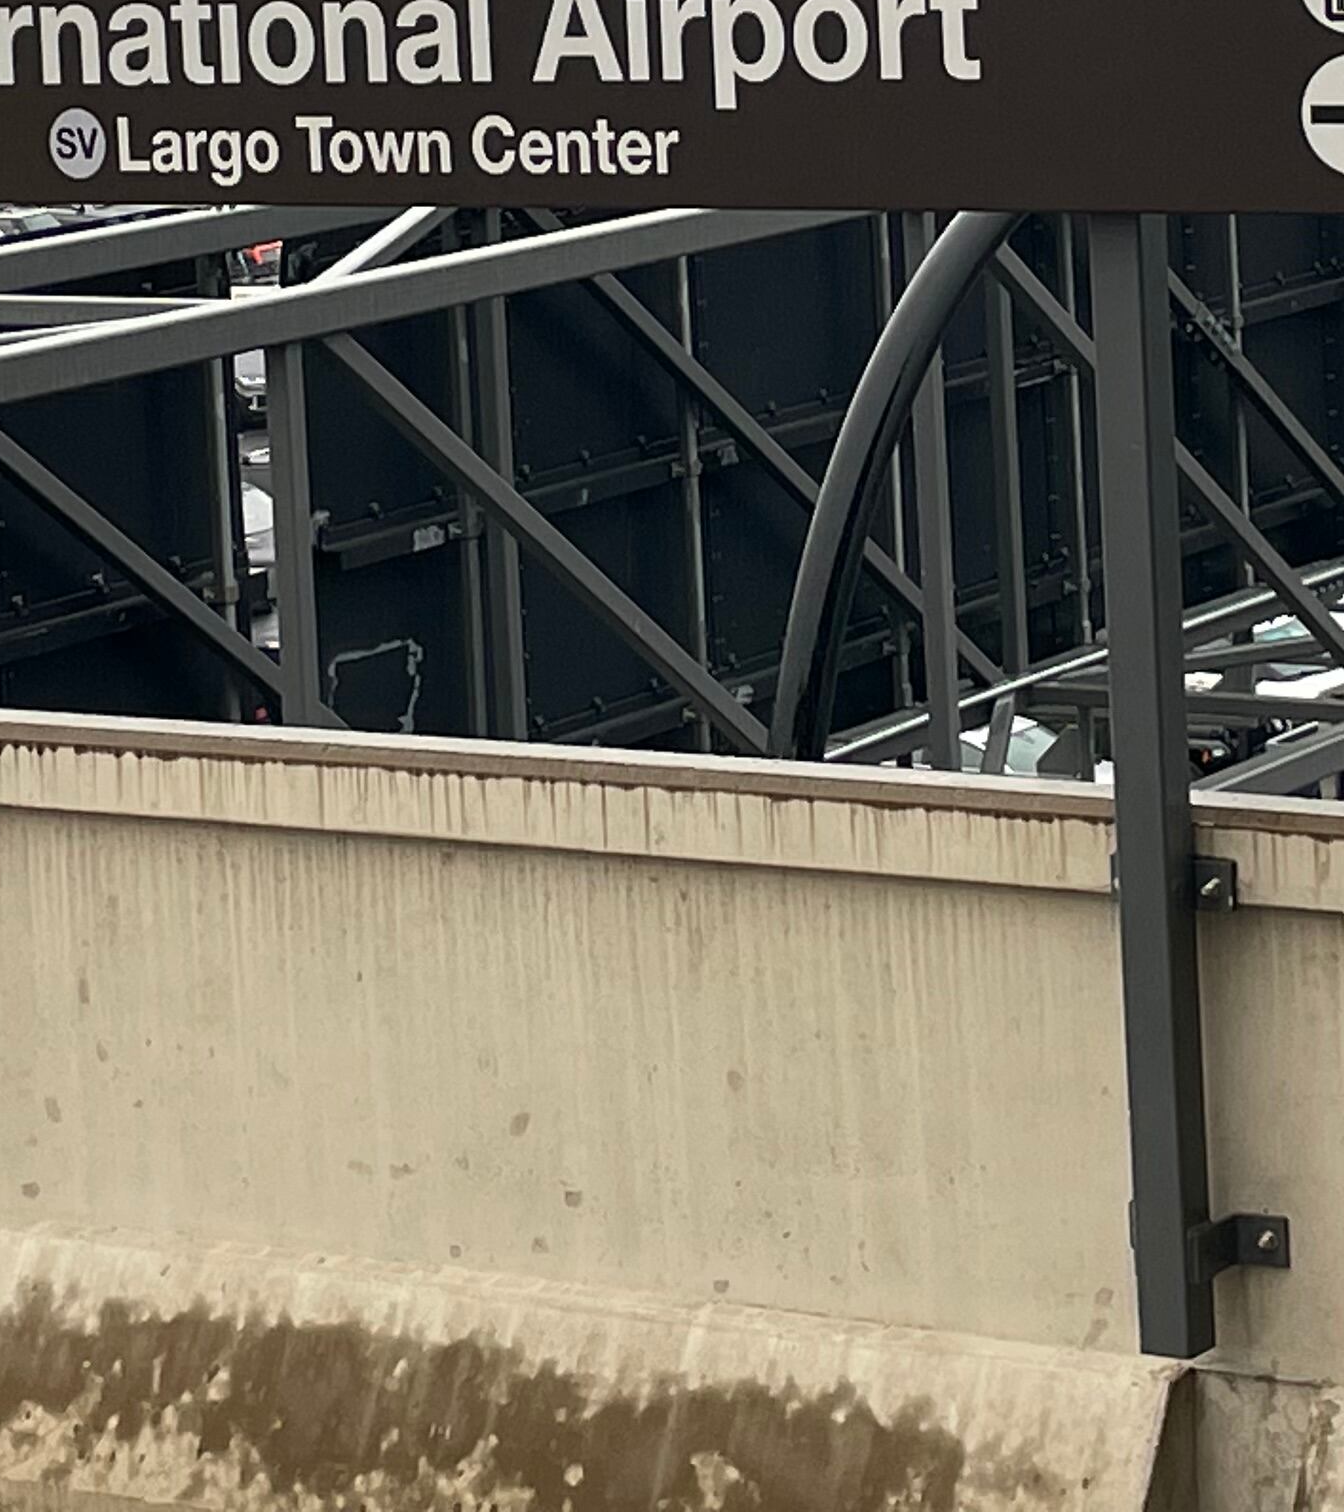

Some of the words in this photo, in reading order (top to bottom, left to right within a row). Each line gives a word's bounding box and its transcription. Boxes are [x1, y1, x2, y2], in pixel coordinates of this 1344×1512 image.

[56, 127, 98, 160] SV
[116, 116, 279, 187] Largo
[295, 116, 452, 174] Town
[471, 114, 679, 175] Center
